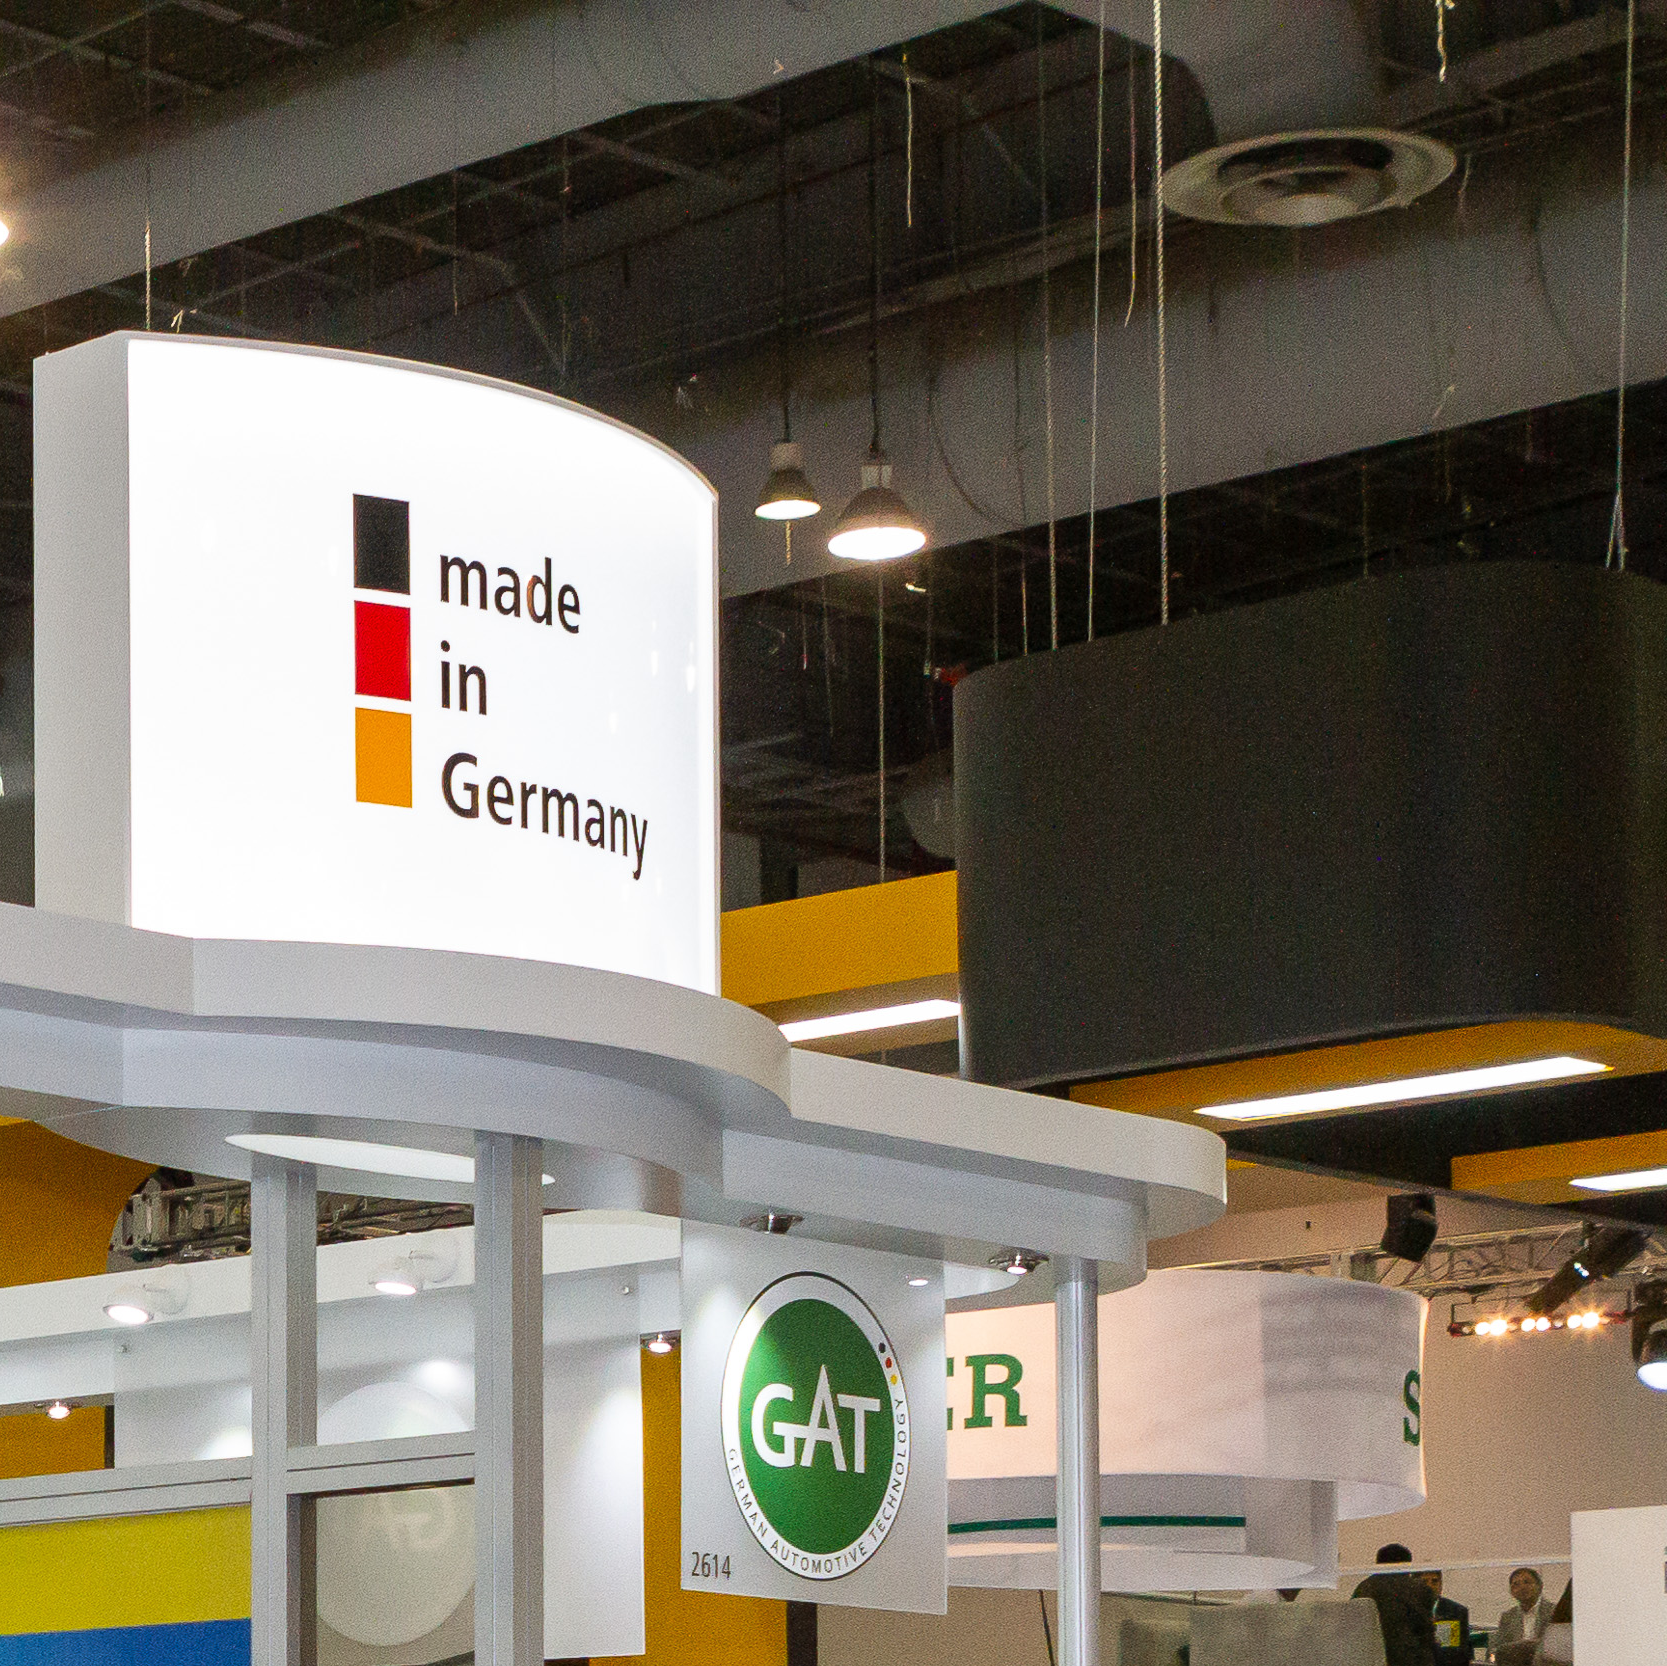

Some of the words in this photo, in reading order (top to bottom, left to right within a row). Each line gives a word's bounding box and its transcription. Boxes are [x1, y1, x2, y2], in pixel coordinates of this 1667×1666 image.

[439, 554, 581, 635] made
[440, 639, 488, 716] in
[441, 751, 649, 881] Germany
[750, 1363, 881, 1475] GAT
[728, 1448, 768, 1539] GERMAN
[769, 1538, 868, 1574] AUTOMOTIVE
[868, 1398, 907, 1544] TECHNOLOGY
[690, 1551, 732, 1580] 2614
